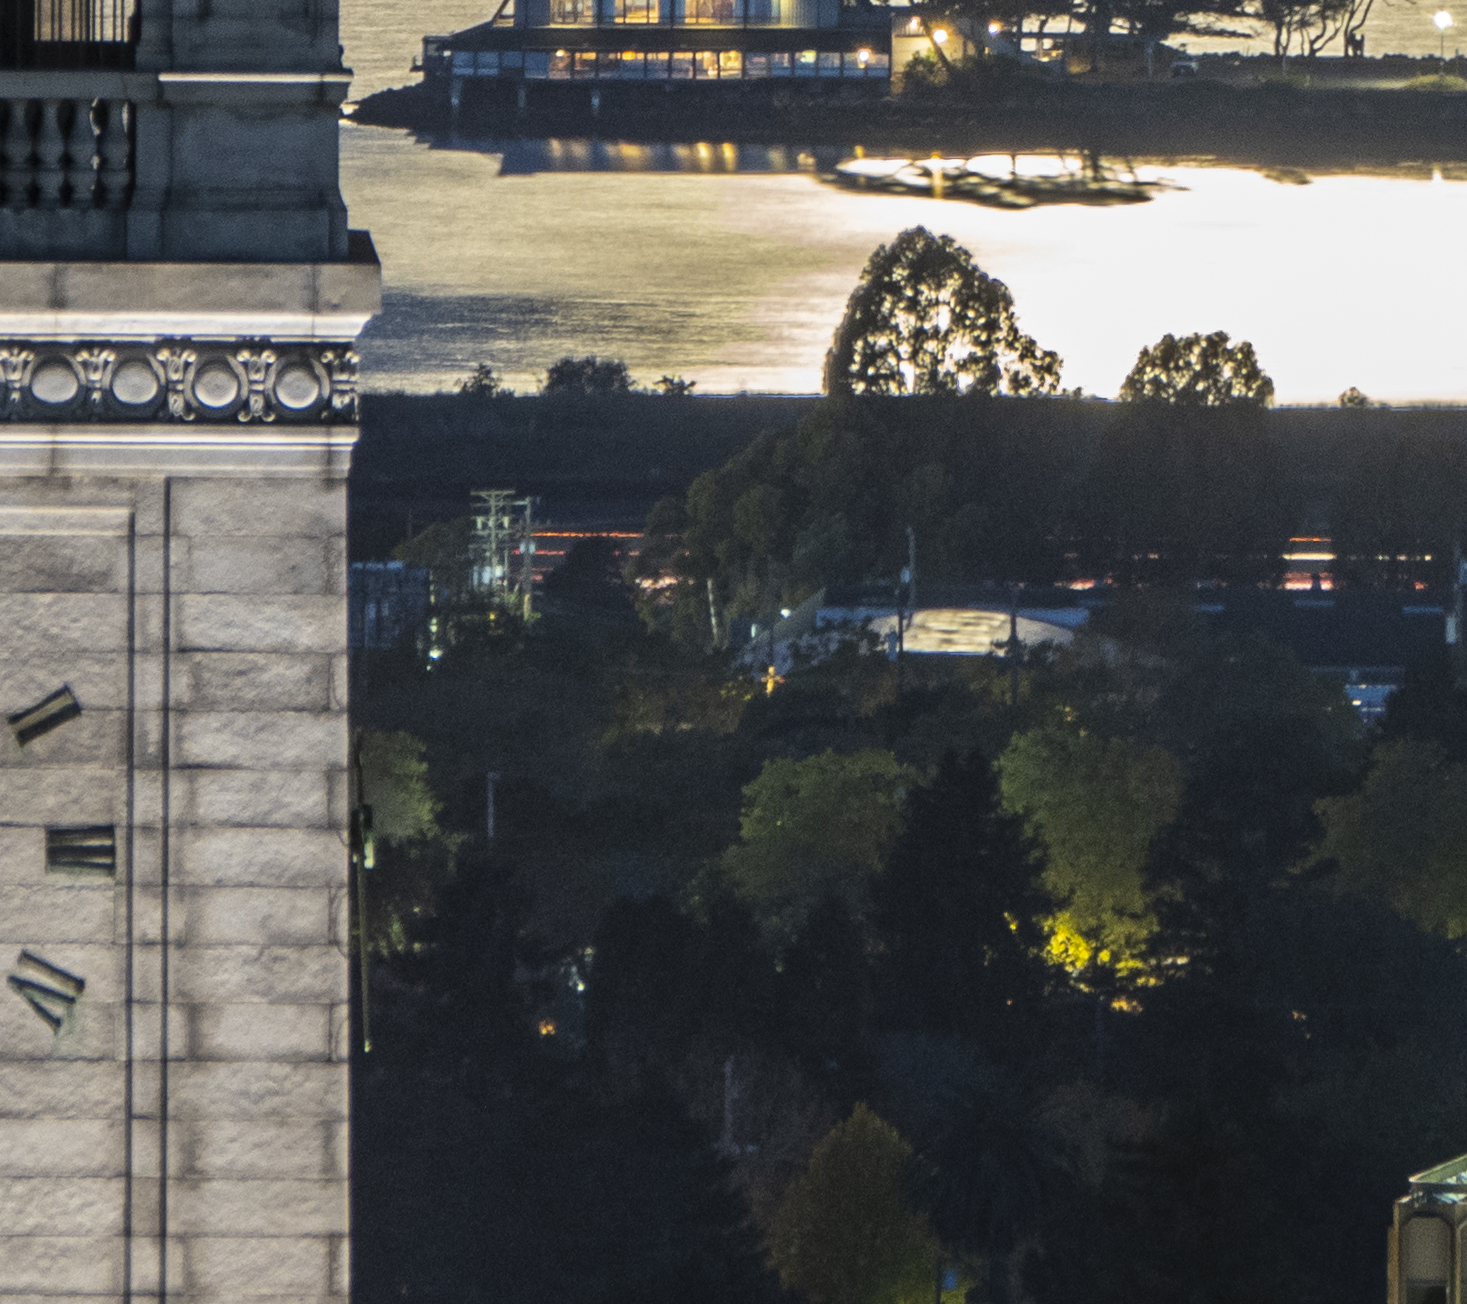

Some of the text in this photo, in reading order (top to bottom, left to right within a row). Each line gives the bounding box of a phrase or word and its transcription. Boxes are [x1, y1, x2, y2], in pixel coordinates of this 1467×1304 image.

[7, 682, 83, 748] II
[44, 823, 116, 874] III
[6, 949, 86, 1031] IV
